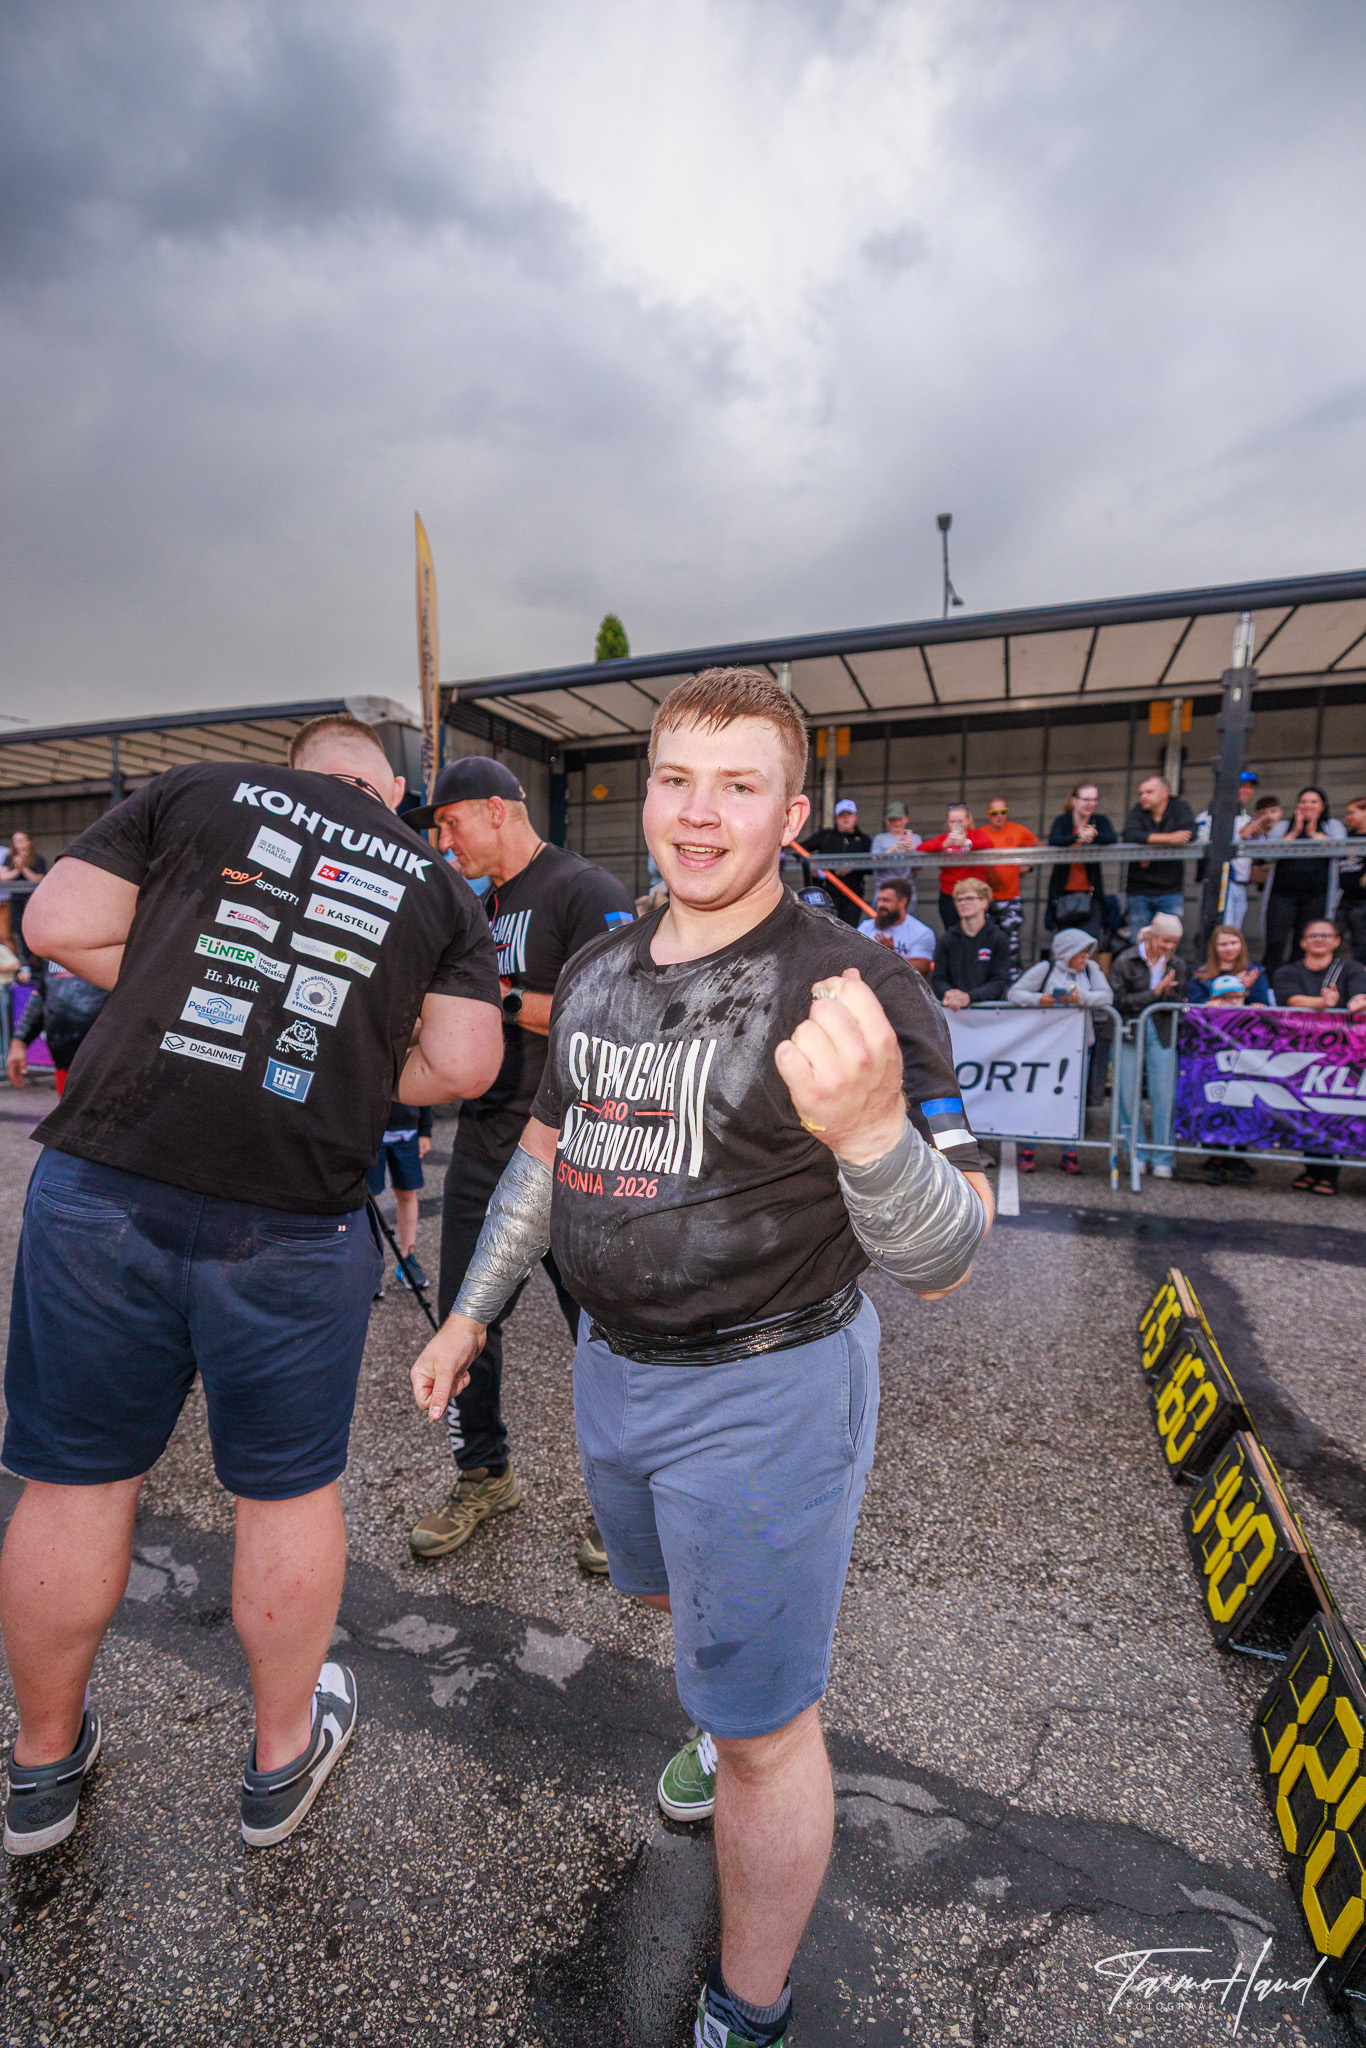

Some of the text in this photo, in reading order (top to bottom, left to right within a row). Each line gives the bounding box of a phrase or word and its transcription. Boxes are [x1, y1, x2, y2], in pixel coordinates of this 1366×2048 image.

[232, 782, 433, 882] KOHTUNIK
[266, 848, 292, 864] HALDUS
[267, 843, 287, 855] EESTI
[221, 867, 250, 881] POP
[255, 879, 300, 905] SPORT!
[326, 909, 380, 935] KASTELLI
[258, 962, 287, 980] logistics
[259, 957, 278, 969] road
[203, 968, 261, 993] Hr. Mulk
[188, 1001, 245, 1023] PesuPatrull
[291, 1000, 334, 1018] STRONGMAN
[189, 1043, 244, 1064] DISAINMET
[273, 1067, 301, 1090] HEI
[613, 1176, 660, 1199] 2026
[1192, 1464, 1277, 1623] 140
